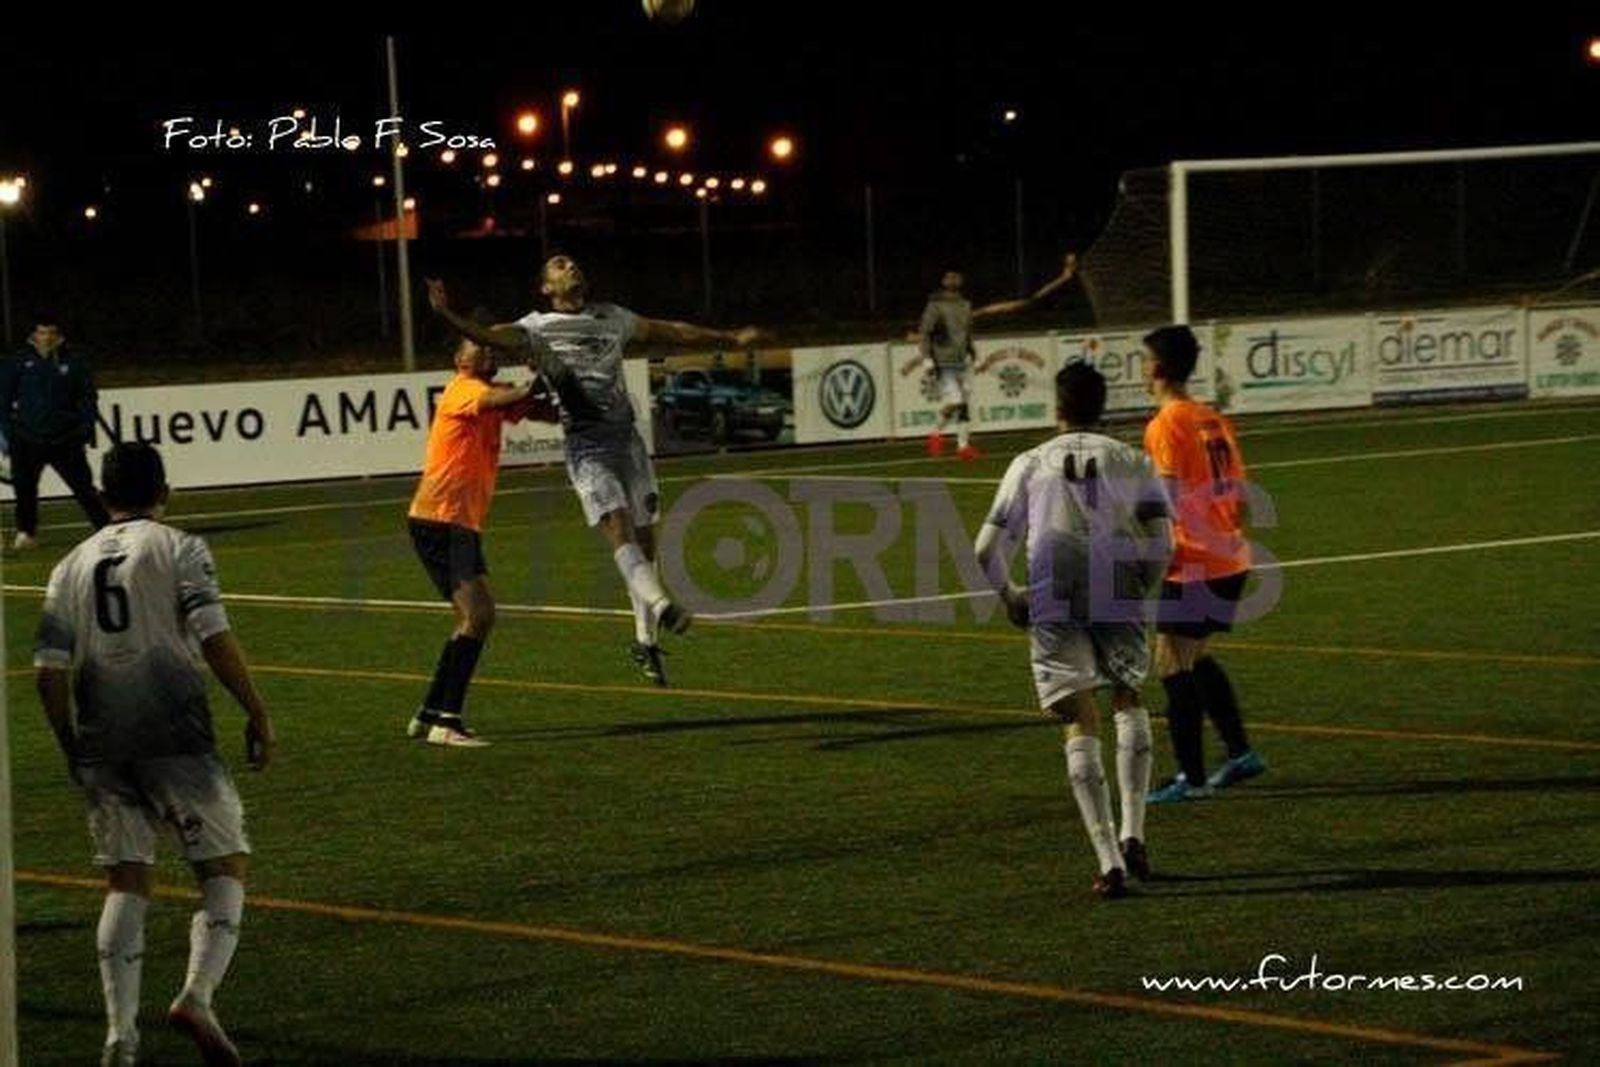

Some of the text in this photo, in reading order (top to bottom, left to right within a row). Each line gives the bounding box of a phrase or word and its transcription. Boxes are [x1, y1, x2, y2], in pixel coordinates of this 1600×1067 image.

[1247, 330, 1355, 384] discyl
[87, 404, 263, 447] Nuevo
[1064, 453, 1098, 510] 4
[95, 555, 130, 634] 6
